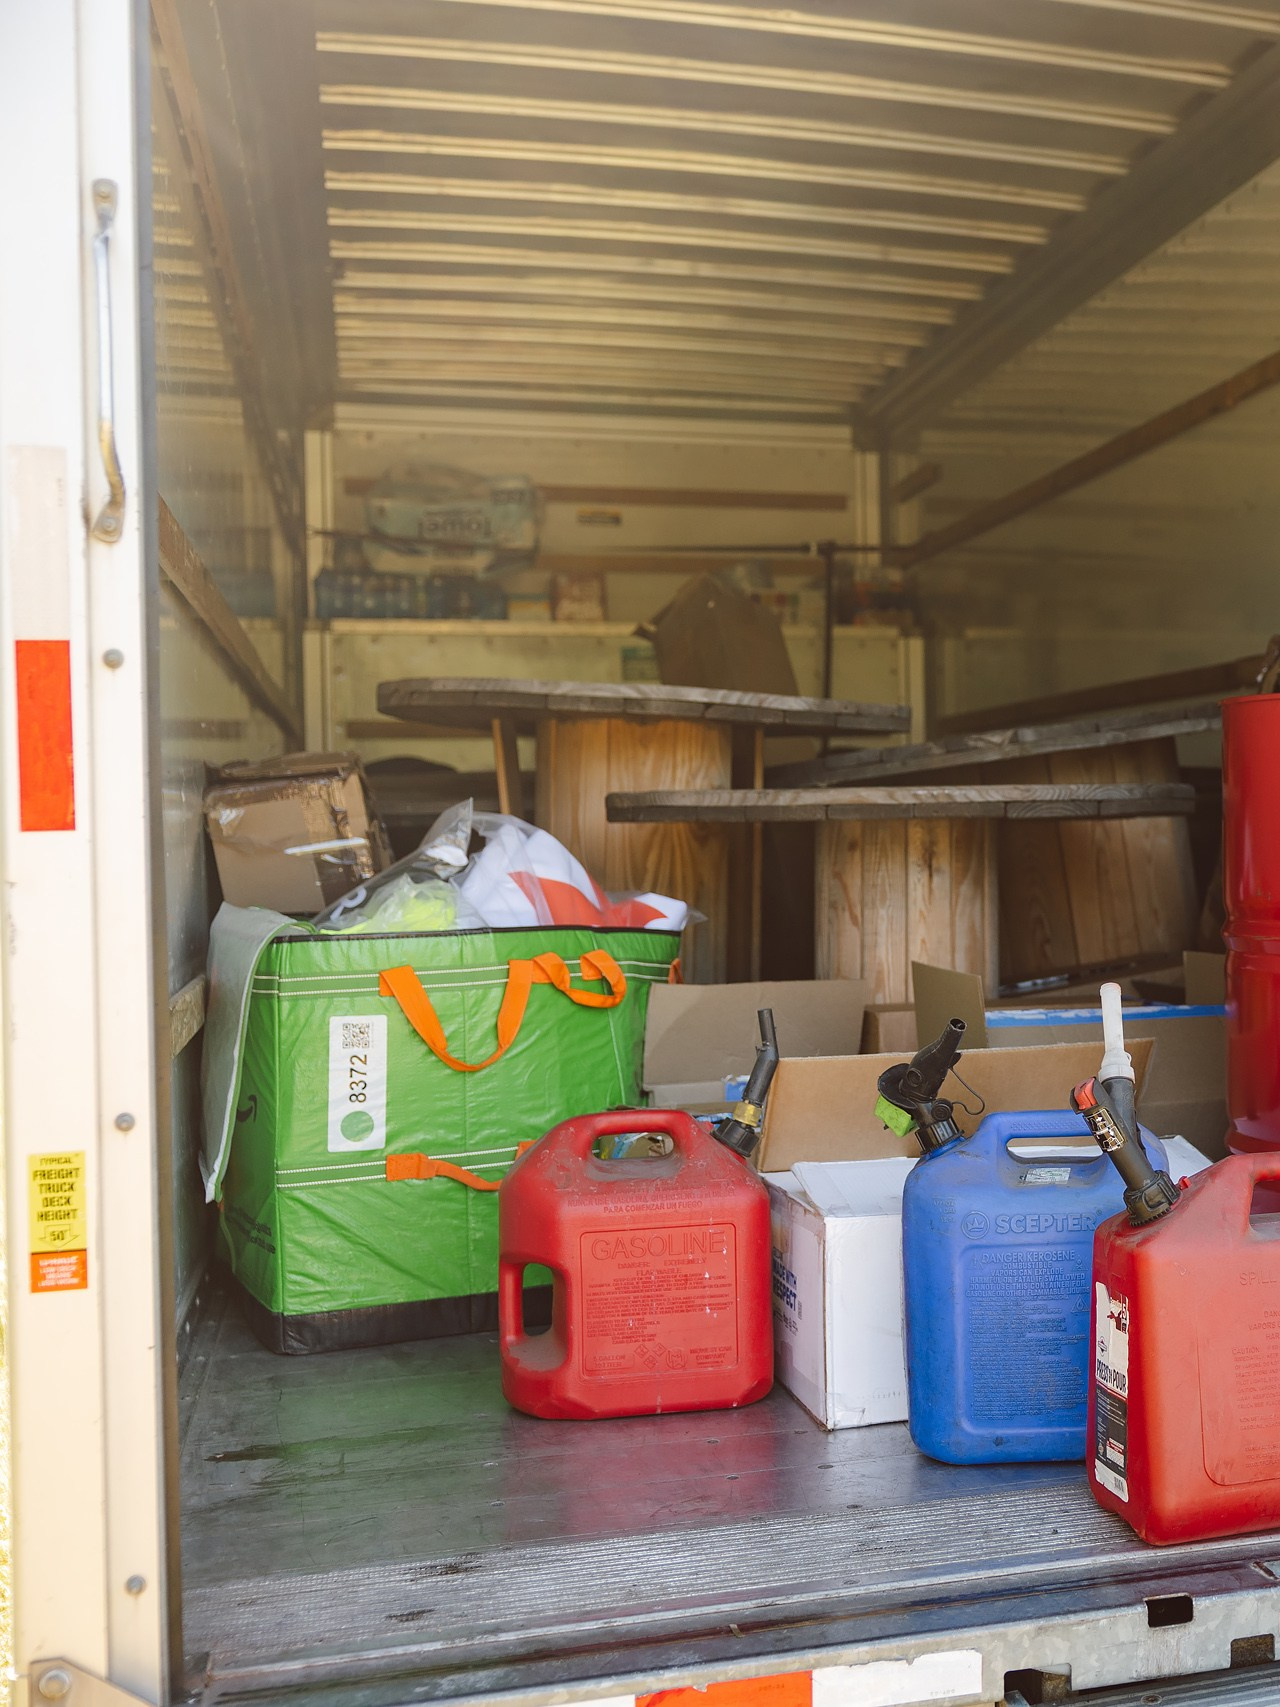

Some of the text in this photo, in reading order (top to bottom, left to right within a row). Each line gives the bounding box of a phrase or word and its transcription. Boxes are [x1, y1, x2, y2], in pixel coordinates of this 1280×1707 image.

[349, 1054, 367, 1103] 8372
[40, 1157, 72, 1165] TYPICAL
[33, 1168, 80, 1181] FREIGHT
[39, 1182, 76, 1194] TRUCK
[42, 1196, 72, 1208] DECK
[604, 1206, 623, 1214] PARA
[625, 1203, 664, 1213] COMENZAR
[678, 1201, 703, 1209] FUEGO
[37, 1209, 78, 1222] HEIGHT
[996, 1213, 1096, 1234] SCEPTER
[591, 1231, 725, 1260] GASOLINE
[664, 1258, 707, 1267] EXTREMELY
[982, 1250, 1075, 1264] DANGER KEROSENE
[1002, 1261, 1052, 1269] COMBUSTIBLE
[991, 1269, 1017, 1277] VAPORS
[1034, 1268, 1064, 1276] EXPLODE
[1015, 1275, 1034, 1283] FATAL
[1044, 1273, 1085, 1282] SWALLOWED
[1239, 1270, 1277, 1286] SPILL
[980, 1283, 995, 1291] NOT
[1030, 1281, 1070, 1289] CONTAINER
[1072, 1280, 1085, 1288] FOR
[966, 1290, 997, 1298] GASOLINE
[1006, 1289, 1026, 1297] OTHER
[1027, 1288, 1066, 1296] FLAMMABLE
[1249, 1321, 1277, 1331] VAPORS
[1232, 1345, 1260, 1356] CAUTION
[1113, 1369, 1127, 1393] POUR
